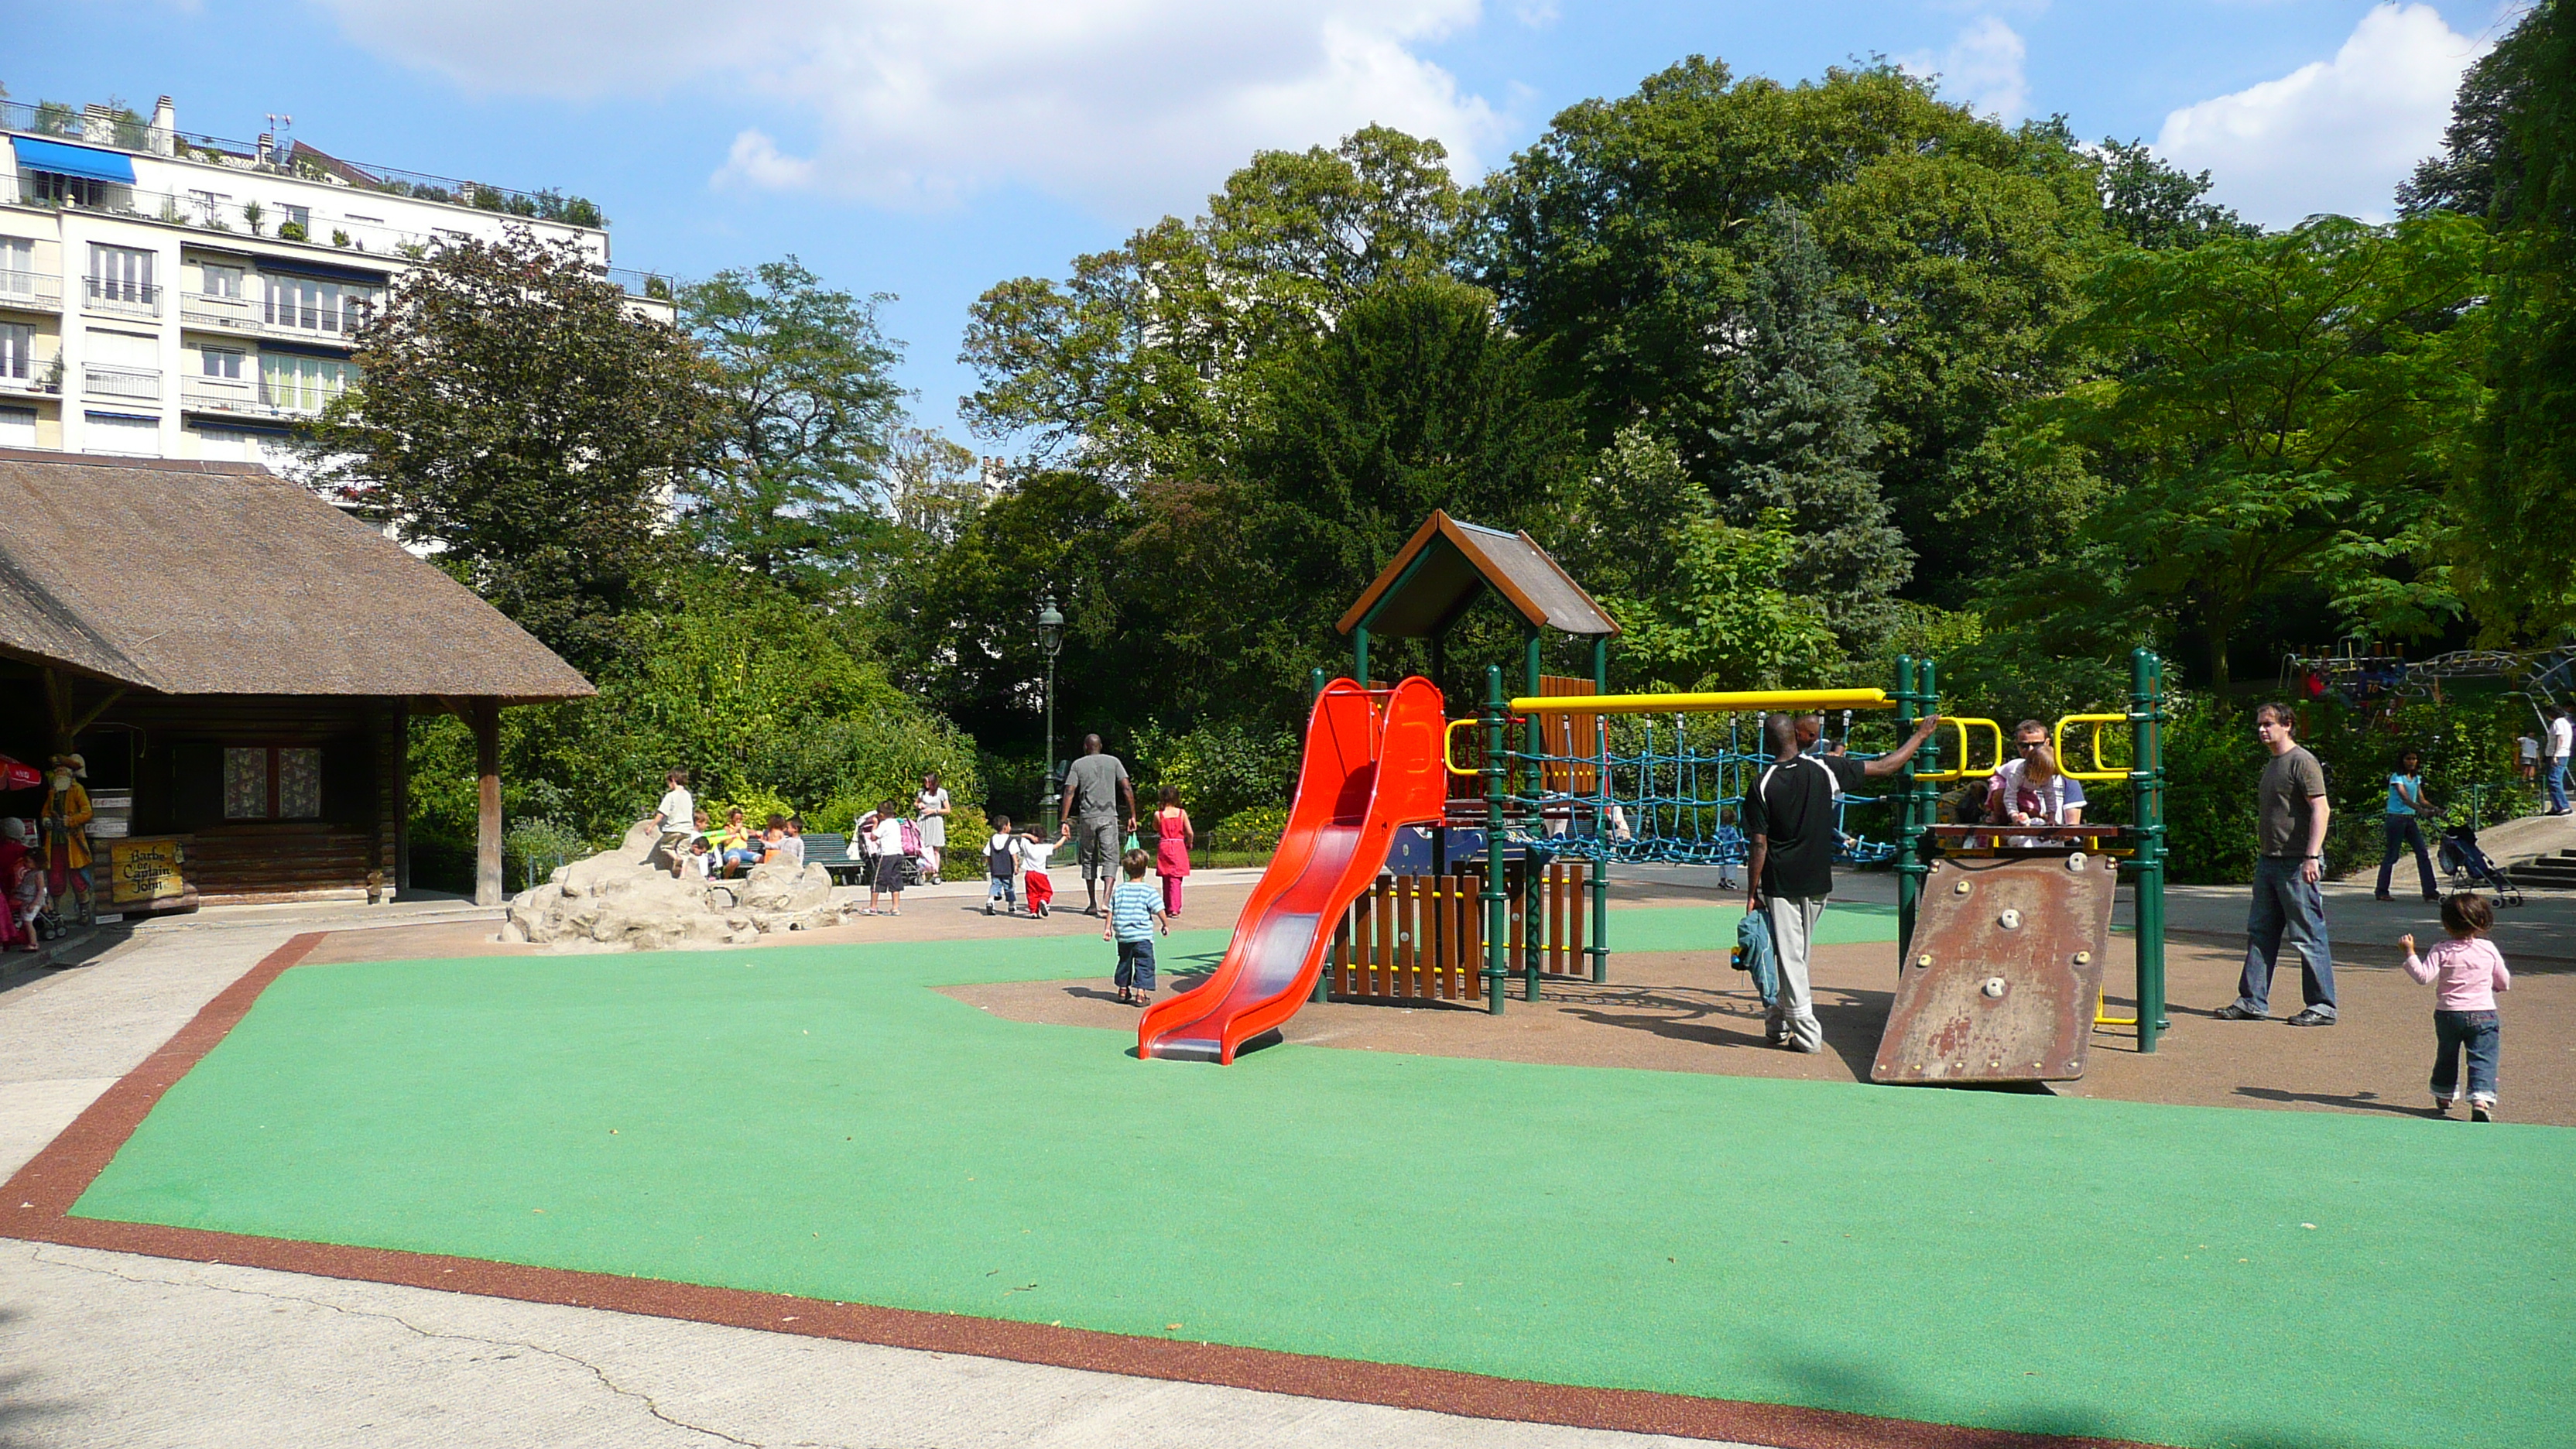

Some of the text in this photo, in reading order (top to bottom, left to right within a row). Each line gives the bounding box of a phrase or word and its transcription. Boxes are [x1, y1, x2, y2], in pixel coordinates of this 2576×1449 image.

[2367, 683, 2379, 694] 10
[131, 846, 166, 862] Barbe
[123, 864, 172, 881] Captain
[132, 878, 163, 893] John
